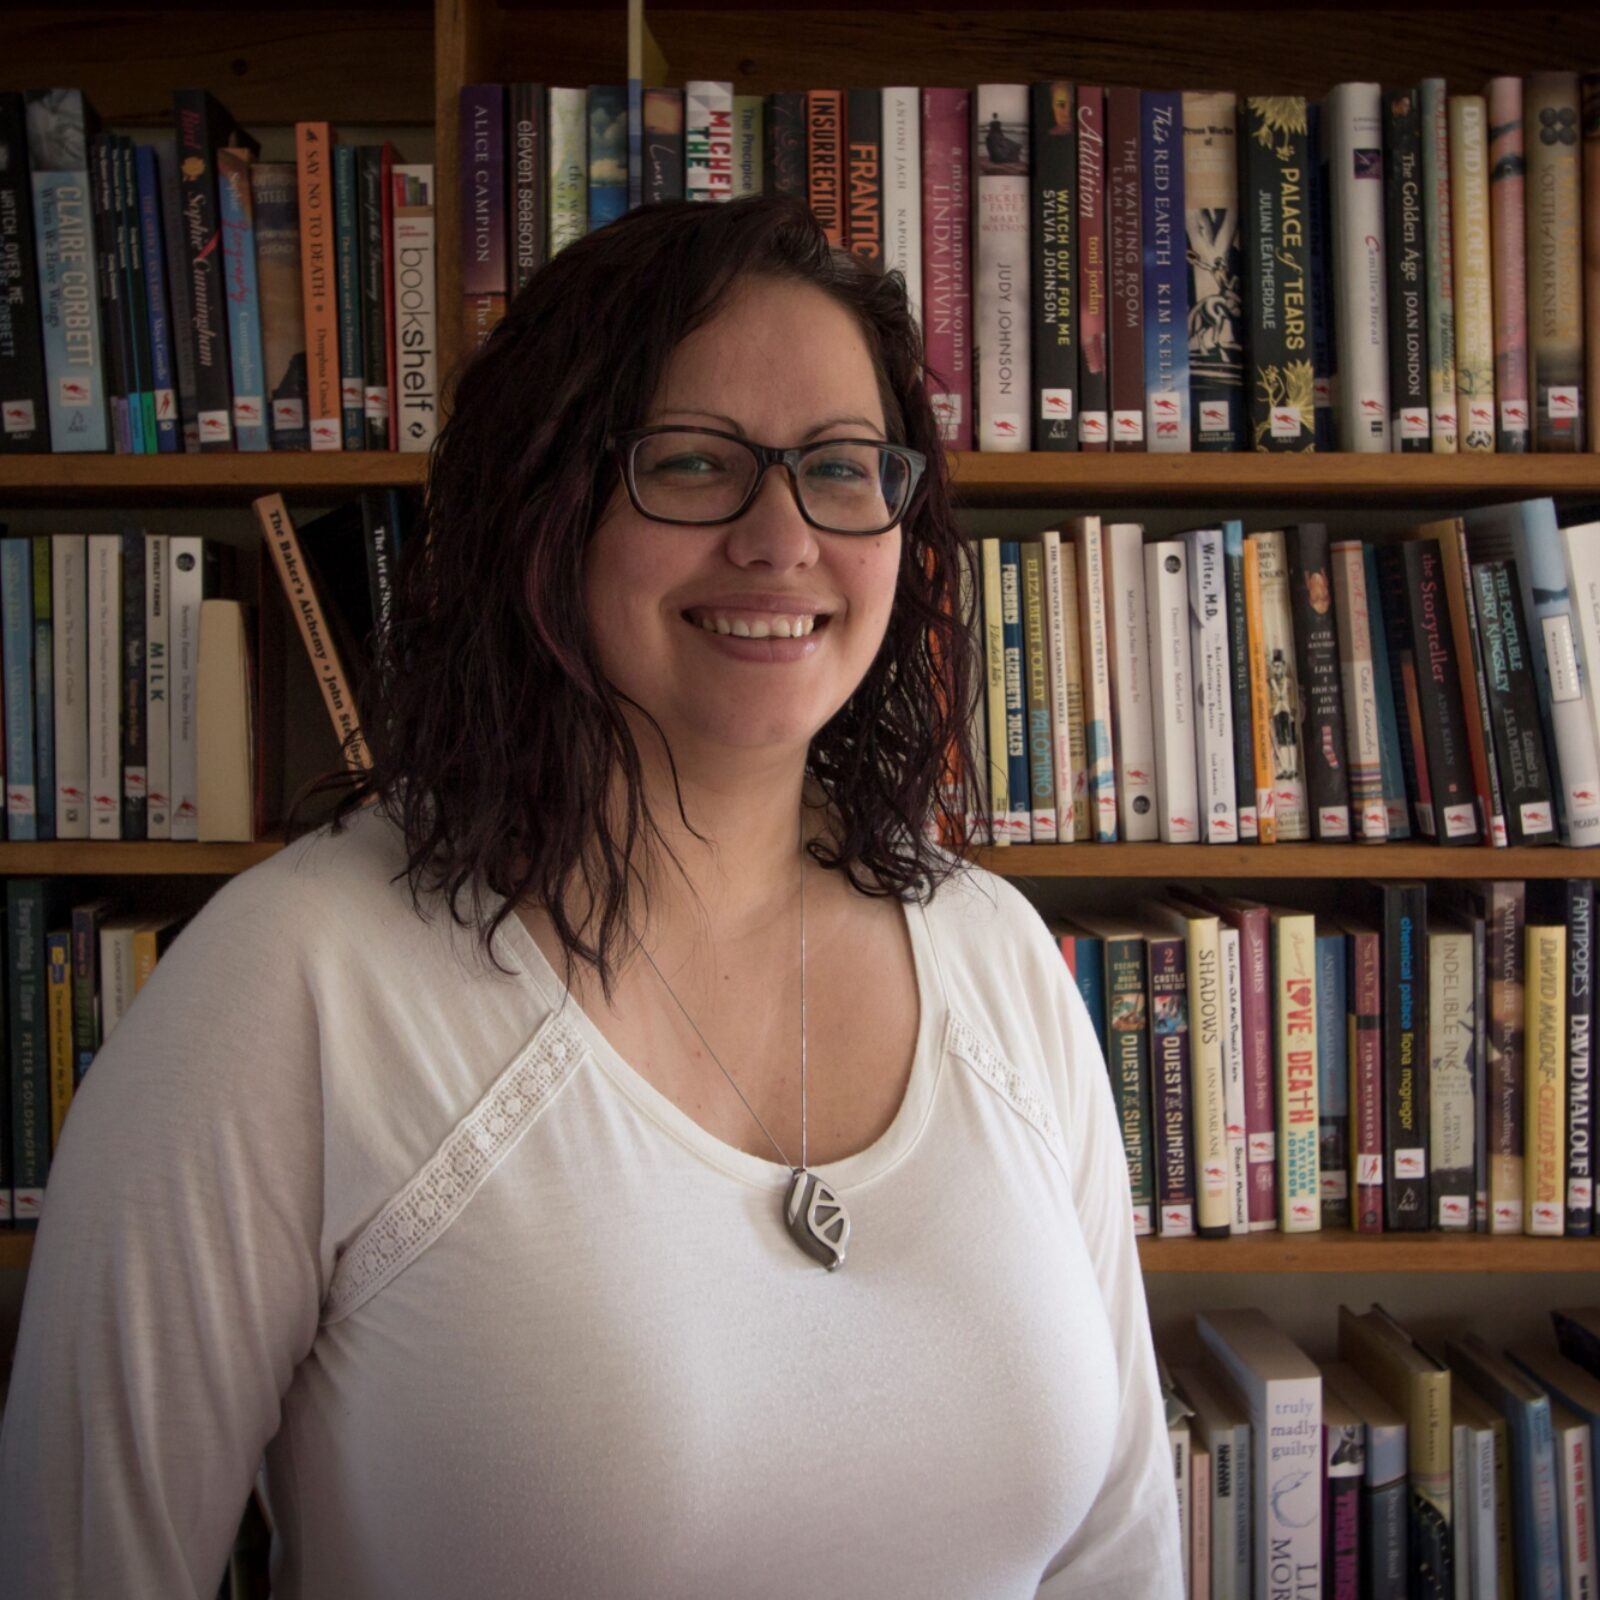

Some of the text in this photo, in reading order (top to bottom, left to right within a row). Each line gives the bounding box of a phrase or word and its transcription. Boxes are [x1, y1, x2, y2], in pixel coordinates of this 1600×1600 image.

[687, 126, 709, 168] THE
[812, 97, 836, 230] INSURRECTION
[896, 100, 907, 151] ANTONI
[896, 157, 907, 189] JACH
[305, 150, 325, 297] SAY NO TO DEATH
[475, 105, 488, 261] ALICE CAMPION
[518, 120, 537, 267] eleven seasons
[849, 144, 879, 258] FRANTIC
[1078, 106, 1102, 315] Addition toni jordan
[1112, 167, 1125, 299] LEAH KAMINSKY
[1123, 138, 1138, 328] THE WAITING ROOM
[1150, 106, 1173, 265] This RED EARTH
[1399, 154, 1420, 281] The Golden Age
[1462, 105, 1485, 273] DAVID MALOUF
[5, 245, 20, 278] OVER
[8, 286, 23, 304] ME
[40, 187, 61, 328] When We Have Wings
[55, 187, 93, 367] CLAIRE CORBETT
[184, 191, 215, 367] Sophie Cunningham
[931, 185, 950, 334] LINDA JAIVIN
[953, 147, 969, 371] a most immoral woman
[1043, 190, 1057, 324] SYLVIA JOHNSON
[1056, 190, 1071, 346] WATCH OUT FOR ME
[1156, 284, 1171, 324] KIM
[1258, 190, 1275, 329] JULIAN LEATHERDALE
[1275, 168, 1304, 349] PALACE of TEARS
[1542, 165, 1556, 337] SOUTH DARKNESS
[314, 328, 329, 416] Dymphna Cusack
[400, 247, 433, 411] bookshelf
[998, 263, 1012, 395] JUDY JOHNSON
[1403, 290, 1421, 396] JOAN LONDON
[268, 510, 328, 660] The Baker's Alchemy
[373, 526, 387, 573] The Art
[1201, 542, 1217, 621] Writer, M.D.
[1480, 572, 1498, 620] HENRY
[149, 643, 164, 702] MILK
[1420, 553, 1455, 765] the Storyteller ADIB KHAN
[1484, 623, 1509, 692] KINGSLEY
[1495, 569, 1523, 671] THE PORTABLE
[321, 676, 344, 709] John
[1027, 559, 1053, 797] ELIZABETH JOLLEY PALOMINO
[1008, 714, 1024, 756] JOLLEY
[1505, 738, 1526, 792] MELLICK
[1523, 730, 1540, 788] Edited by
[1164, 948, 1175, 963] 2
[1199, 950, 1218, 1045] SHADOWS
[1252, 939, 1265, 993] STORIES
[1397, 917, 1413, 1029] chemical palace
[1502, 901, 1516, 1012] EMILY MAGUIRE
[1572, 896, 1589, 997] ANTIPODES
[1254, 1030, 1267, 1078] Elizabeth
[1443, 942, 1460, 1070] INDELIBLE INK
[1538, 939, 1557, 1078] DAVID MALOUF
[21, 1032, 36, 1187] PETER GOLDSWORTHY
[1119, 1034, 1139, 1092] QUEST
[1163, 1035, 1182, 1093] QUEST
[1364, 1042, 1373, 1078] FIONA
[1398, 1032, 1415, 1131] fiona mcgregor
[1500, 1020, 1516, 1145] The According
[1570, 1014, 1589, 1175] DAVID MALOUF
[1165, 1110, 1187, 1189] SUNFISH
[1287, 1131, 1297, 1198] JOHNSON
[1297, 1138, 1306, 1190] TAYLOR
[1307, 1130, 1316, 1195] HEATHER
[1270, 1420, 1318, 1441] madly
[1271, 1443, 1317, 1461] guilty
[1274, 1398, 1315, 1416] truly
